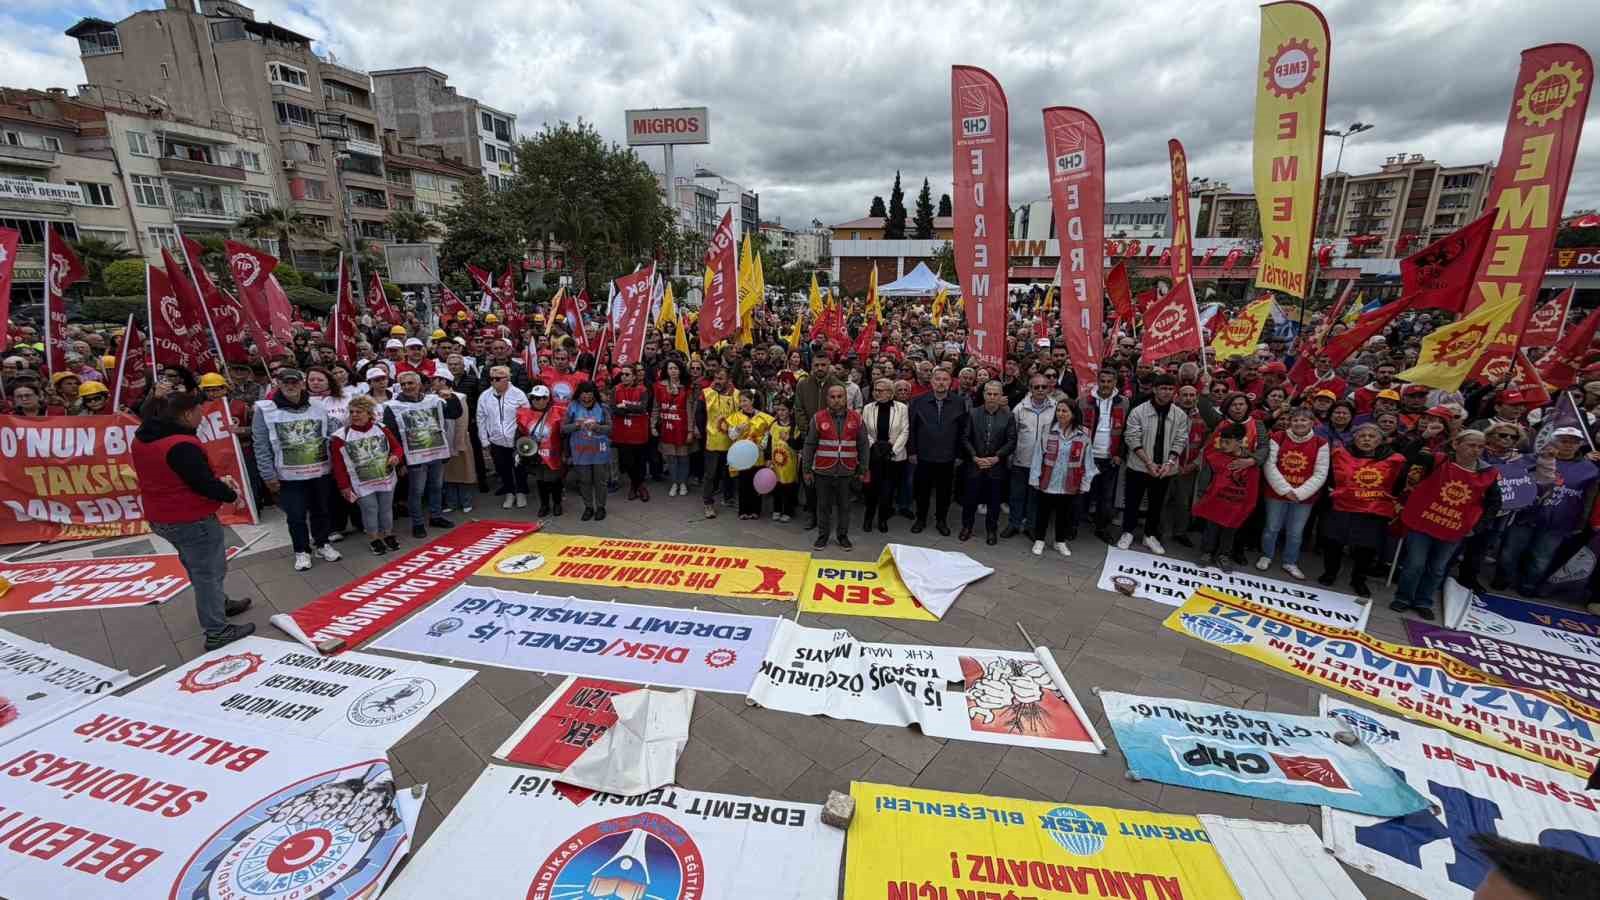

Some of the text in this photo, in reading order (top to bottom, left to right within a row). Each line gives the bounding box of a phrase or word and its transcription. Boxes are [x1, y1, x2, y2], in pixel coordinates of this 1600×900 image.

[1007, 239, 1047, 256] MM
[77, 496, 144, 523] EDE
[1429, 502, 1463, 521] EMEK
[557, 545, 749, 570] KÜLTÜR DERNEĞİ
[340, 545, 454, 602] PLATFORMU
[612, 566, 685, 587] SULTAN
[686, 572, 721, 591] PİR
[1118, 564, 1173, 583] VAKFI
[1152, 560, 1320, 601] ZEYTİNLİ CEMEVİ
[813, 582, 896, 606] SEN
[1144, 583, 1187, 600] VELİ
[312, 573, 439, 645] DAYANIŞMA
[624, 618, 753, 641] EDREMİT
[1180, 612, 1255, 644] KESK
[794, 642, 853, 663] MAYIS
[905, 649, 934, 660] KHK
[1268, 638, 1316, 661] İÇİN
[256, 673, 349, 698] DERNEKLERİ
[1321, 656, 1412, 692] ADALET
[220, 691, 276, 718] KÜLTÜR
[924, 681, 943, 711] İŞ
[1421, 691, 1451, 712] VE
[266, 700, 324, 722] ALEVİ
[73, 713, 270, 773] BALIKESİR
[1463, 703, 1600, 758] ZGÜRLÜK
[1184, 742, 1272, 775] CHP
[0, 750, 208, 818] SENDİKASI
[1422, 743, 1600, 812] EŞENLERİ
[685, 798, 807, 827] EDREMİT
[874, 795, 1211, 844] DREMİT BİLEŞENLERİ
[1038, 814, 1108, 837] KESK
[532, 838, 584, 900] ENDİKASI
[969, 853, 1183, 900] ALANLARDAYIZ
